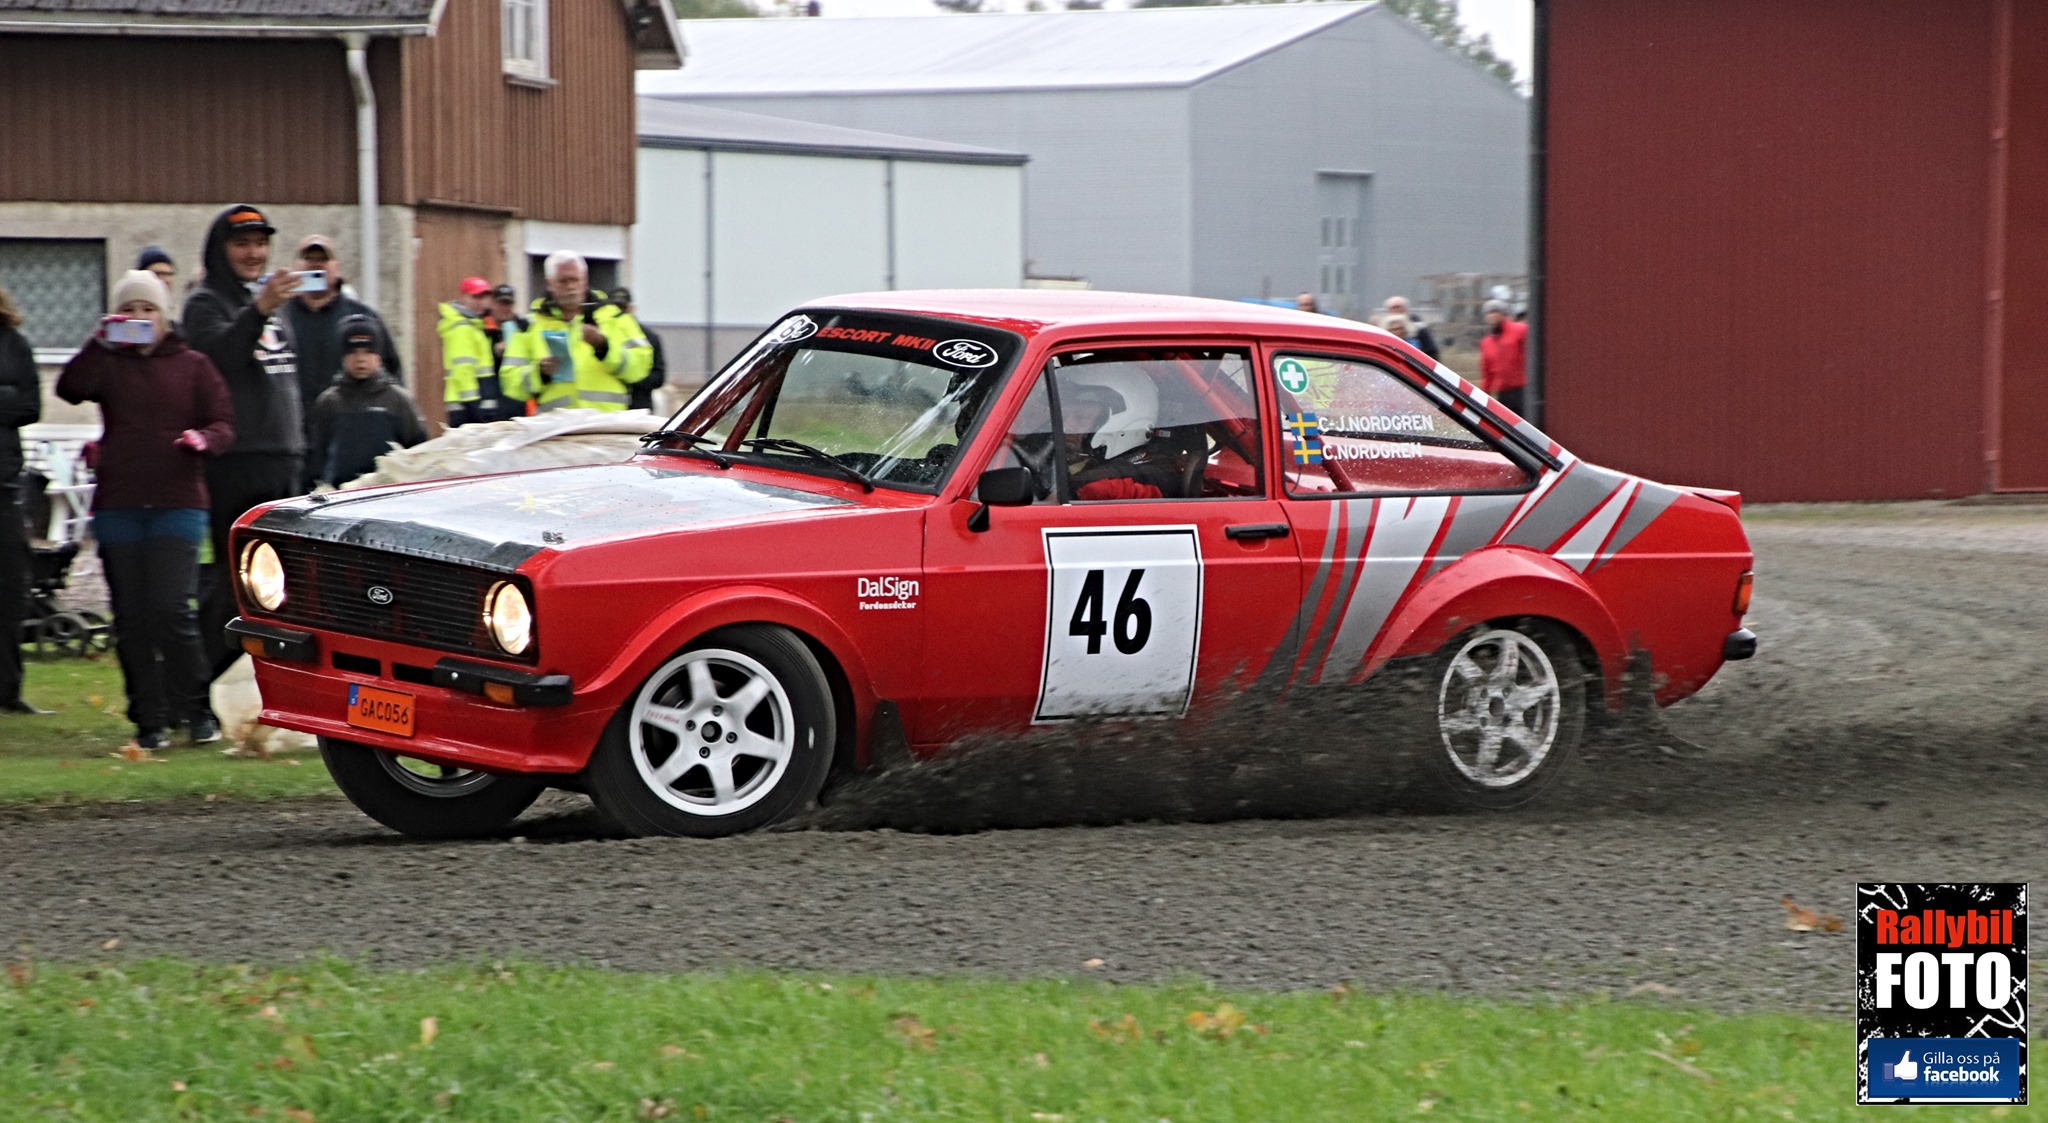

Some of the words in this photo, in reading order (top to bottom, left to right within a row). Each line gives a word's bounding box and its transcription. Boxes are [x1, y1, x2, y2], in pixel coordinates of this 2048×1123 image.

[816, 326, 891, 342] ESCORT
[891, 334, 937, 351] MKII
[942, 342, 987, 363] Ford
[1319, 414, 1434, 432] C-J.NORDGREN
[1322, 442, 1422, 460] C.NORDGREN
[857, 576, 919, 600] DalSign
[1069, 568, 1152, 655] 46
[361, 698, 409, 725] GAC056
